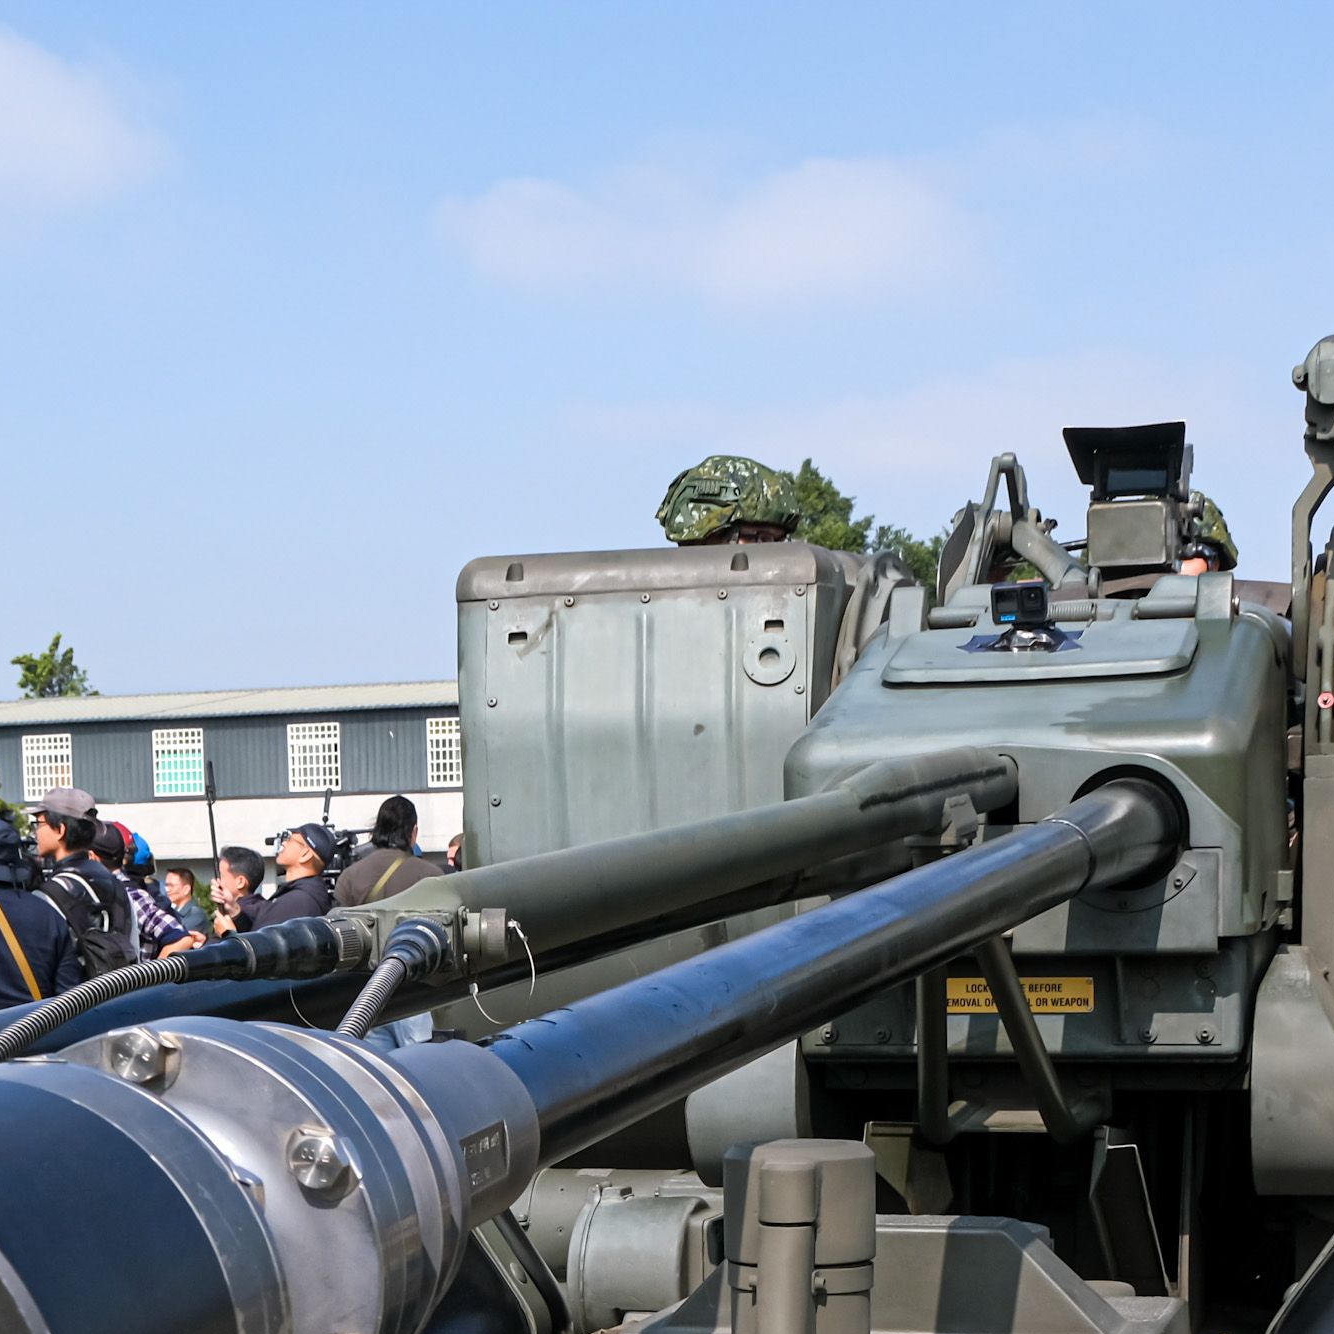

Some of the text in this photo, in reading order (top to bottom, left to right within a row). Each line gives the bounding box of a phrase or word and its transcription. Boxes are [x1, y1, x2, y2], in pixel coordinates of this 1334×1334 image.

[966, 984, 989, 993] LOCK
[1028, 983, 1063, 993] BEFORE
[947, 998, 982, 1007] EMOVAL
[1035, 997, 1048, 1007] OR
[1051, 997, 1089, 1007] WEAPON
